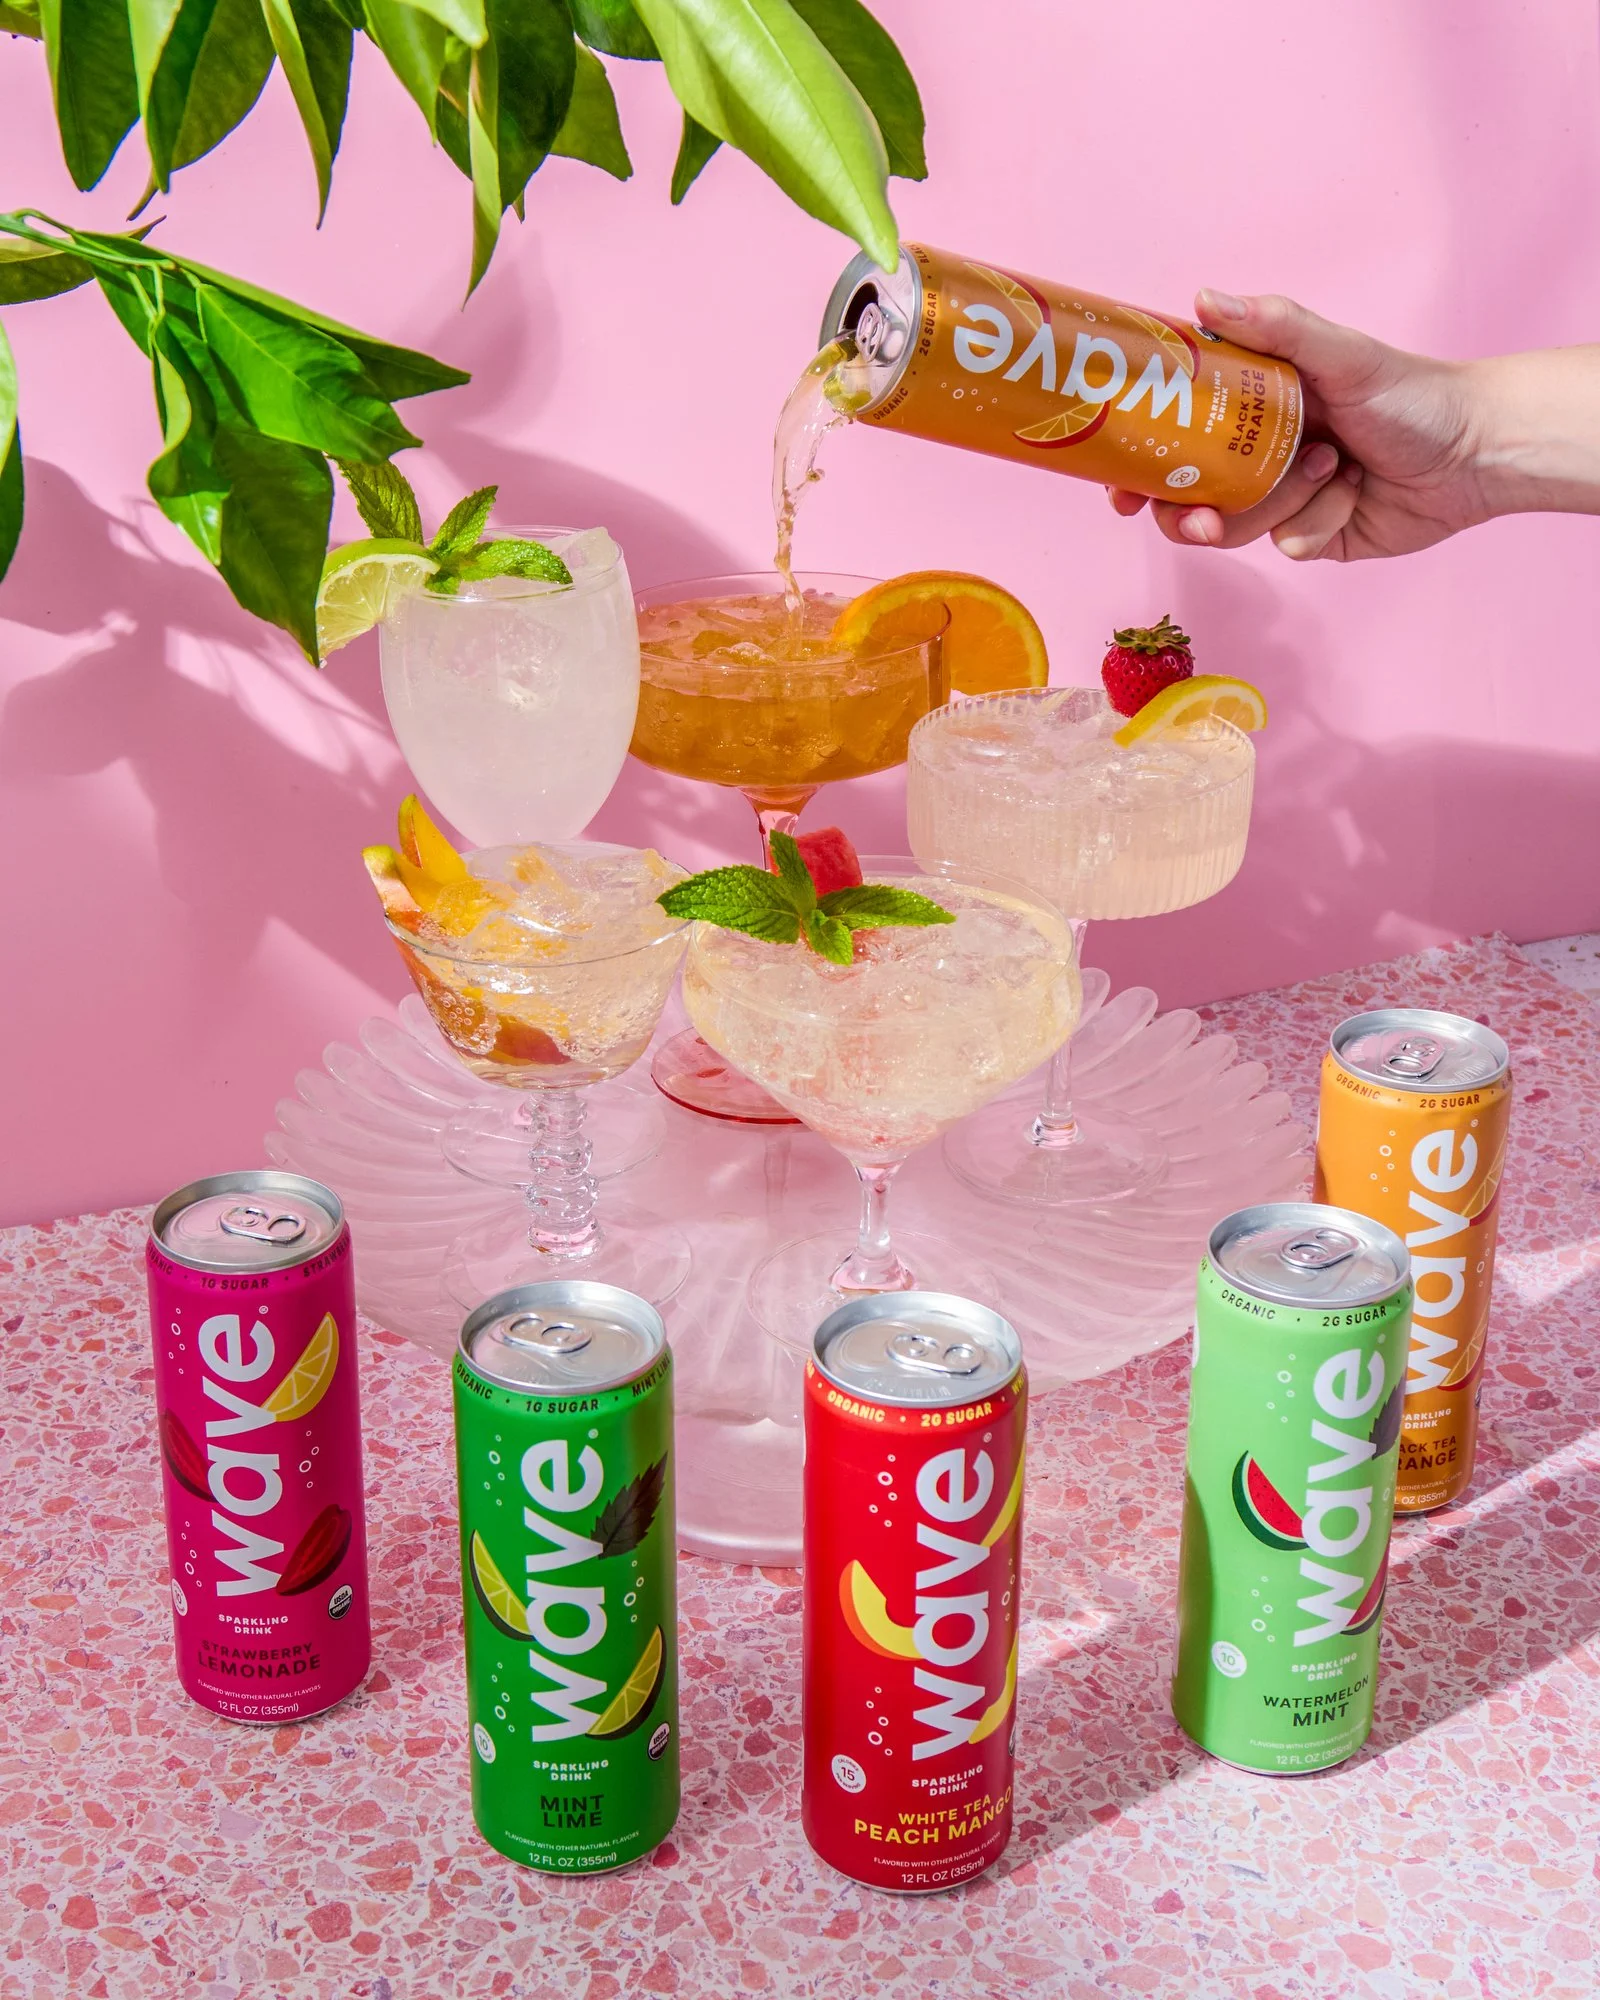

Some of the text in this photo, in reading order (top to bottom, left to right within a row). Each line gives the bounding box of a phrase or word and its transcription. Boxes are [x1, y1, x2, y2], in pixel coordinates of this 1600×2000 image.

[873, 387, 908, 420] ORGANIC
[920, 338, 931, 356] 2G
[926, 291, 937, 335] SUGAR
[1204, 370, 1221, 433] SPARKLING
[1217, 387, 1228, 421] DRINK
[1228, 369, 1251, 450] BLACK TEA
[1241, 370, 1266, 456] ORANGE
[1276, 386, 1297, 460] 12 FL OZ (355ml)
[1270, 434, 1278, 449] WITH
[1336, 1074, 1480, 1108] ORGANIC 2G SUGAR
[201, 1278, 216, 1288] 1G
[221, 1278, 269, 1290] SUGAR
[1222, 1290, 1387, 1327] ORGANIC 2G SUGAR
[457, 1364, 493, 1399] ORGANIC
[526, 1400, 542, 1413] 1G
[548, 1399, 599, 1413] SUGAR
[632, 1372, 657, 1398] MINT
[827, 1390, 992, 1427] ORGANIC 2G SUGAR
[1402, 1408, 1452, 1420] ARKLING
[1404, 1420, 1437, 1429] DRINK
[1400, 1436, 1456, 1454] ACK TEA
[1398, 1447, 1456, 1470] ANGE
[1402, 1496, 1416, 1504] OZ
[219, 1614, 288, 1626] SPARKLING
[234, 1626, 272, 1634] DRINK
[202, 1640, 312, 1660] STRAWBERRY
[1221, 1652, 1236, 1666] 10
[198, 1652, 320, 1678] LEMONADE
[1292, 1652, 1358, 1673] SPARKLING
[1308, 1667, 1343, 1682] DRINK
[198, 1679, 224, 1694] FLAVORED
[225, 1690, 240, 1699] WITH
[264, 1692, 292, 1700] NATURAL
[294, 1684, 321, 1697] FLAVORS
[1263, 1675, 1369, 1708] WATERMELON
[218, 1700, 299, 1715] 12 FL OZ (355ml)
[1293, 1702, 1349, 1727] MINT
[478, 1736, 488, 1750] 10
[533, 1760, 609, 1771] SPARKLING
[1276, 1755, 1288, 1765] 12
[1290, 1755, 1302, 1765] FL
[1304, 1752, 1321, 1763] OZ
[551, 1772, 591, 1781] DRINK
[841, 1767, 855, 1781] 15
[912, 1765, 983, 1788] SPARKLING
[929, 1782, 968, 1797] DRINK
[540, 1794, 604, 1813] MINT
[898, 1794, 991, 1825] WHITE TEA
[544, 1811, 602, 1829] LIME
[854, 1786, 1012, 1844] PEACH MANGO
[505, 1831, 535, 1847] FLAVORED
[537, 1842, 554, 1850] WITH
[580, 1842, 611, 1851] NATURAL
[612, 1831, 640, 1846] FLAVORS
[529, 1852, 617, 1867] 12 FL OZ (355ml)
[874, 1857, 910, 1868] FLAVORED
[911, 1860, 930, 1868] WITH
[931, 1857, 953, 1866] OTHER
[954, 1847, 980, 1862] NATURAL
[901, 1856, 985, 1883] 12 FL OZ (355ml)
